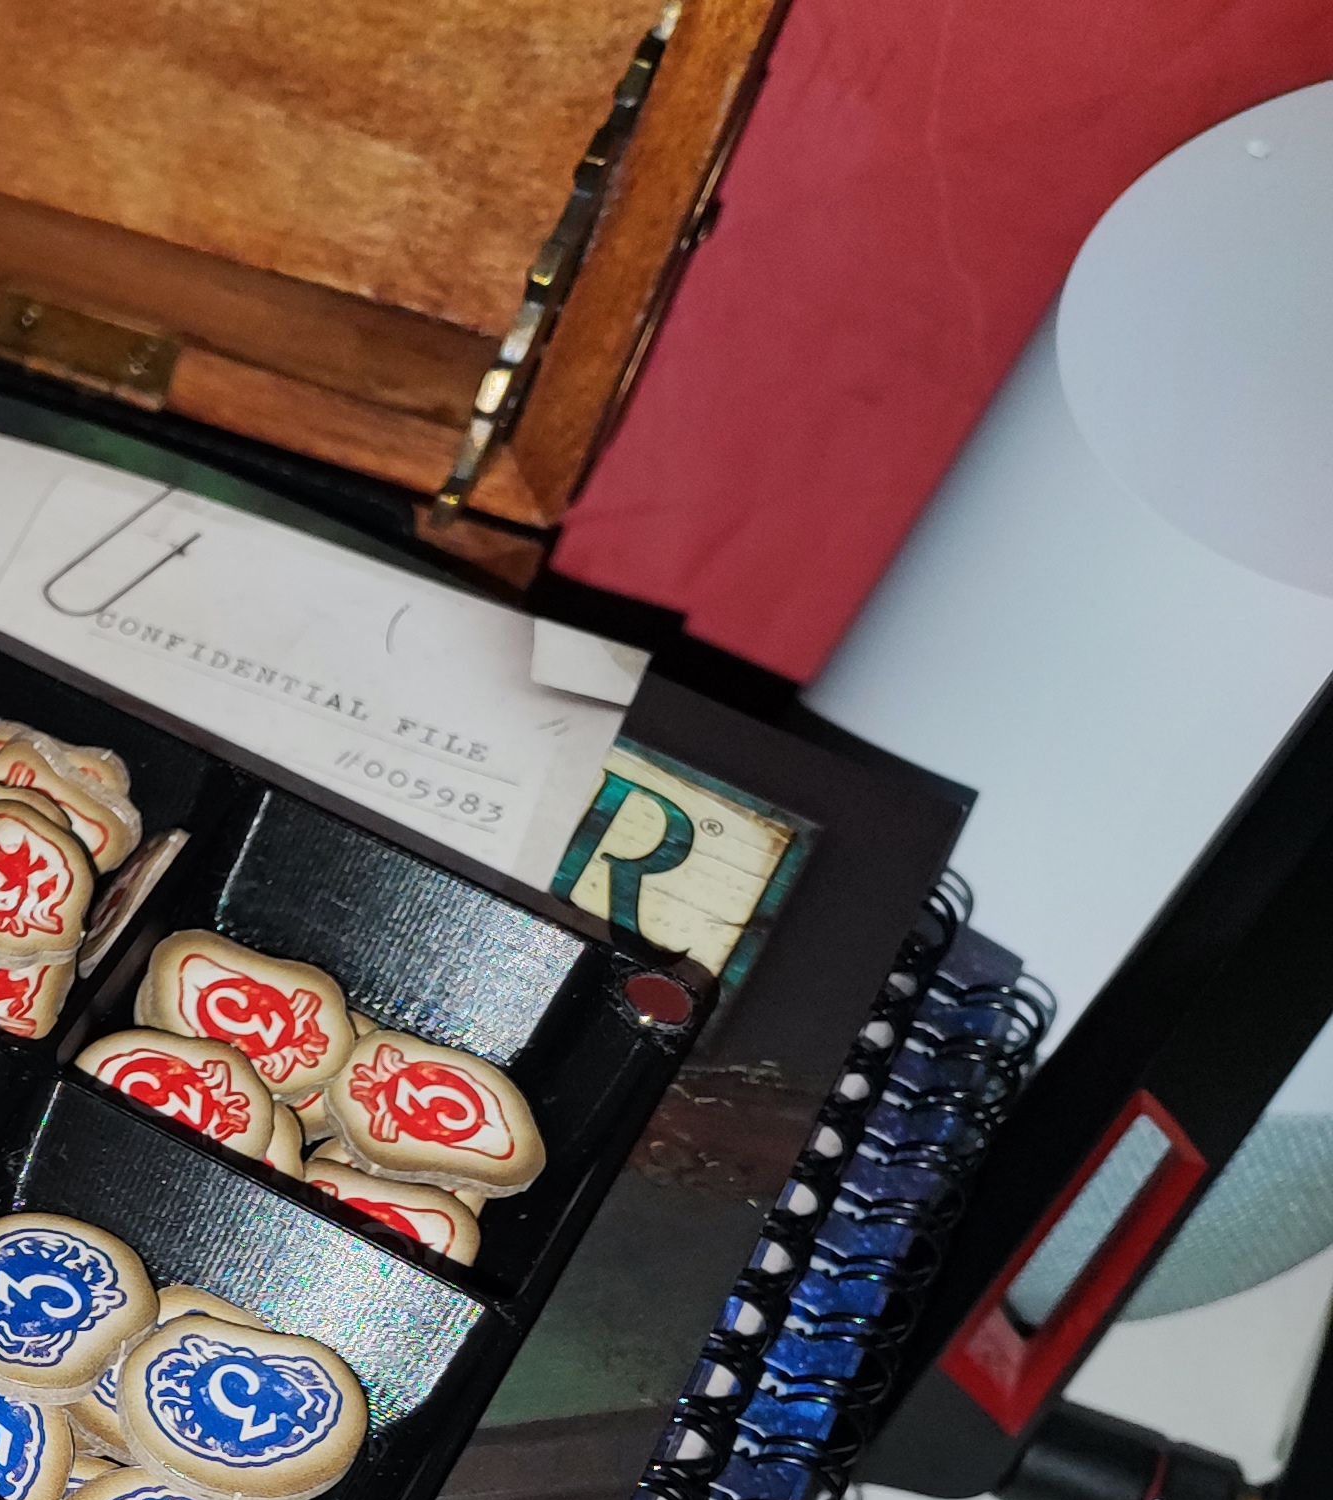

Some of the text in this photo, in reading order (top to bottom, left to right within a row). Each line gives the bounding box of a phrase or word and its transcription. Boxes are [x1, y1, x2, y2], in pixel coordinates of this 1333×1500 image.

[93, 607, 490, 764] CONFIDENTIAL FILE
[205, 987, 287, 1048] 3
[120, 1073, 203, 1124] 3
[396, 1077, 477, 1131] 3
[209, 1363, 278, 1443] 3
